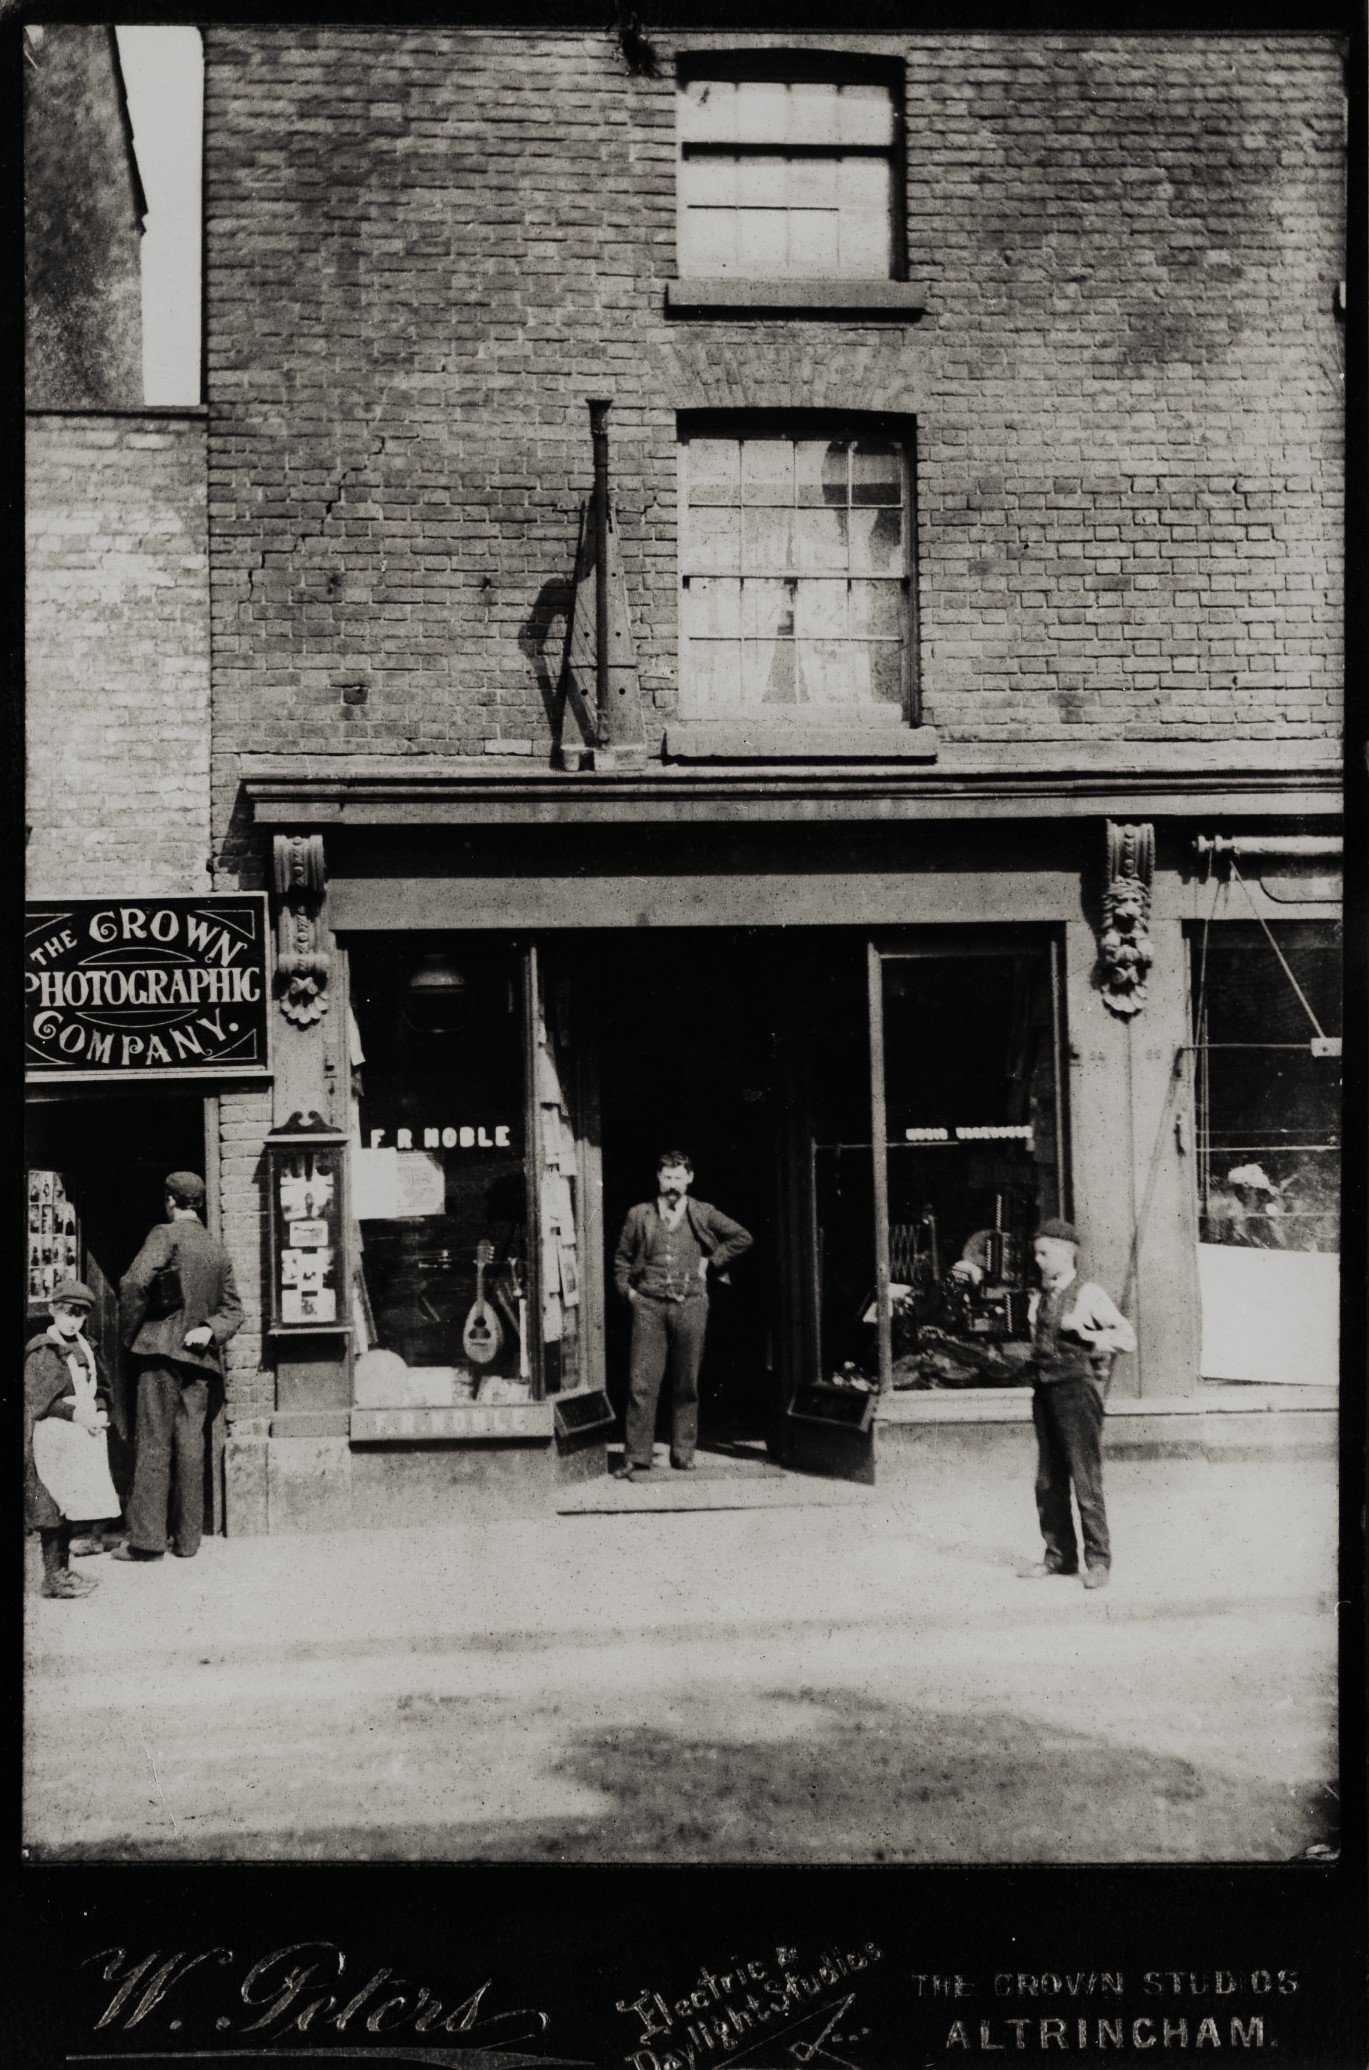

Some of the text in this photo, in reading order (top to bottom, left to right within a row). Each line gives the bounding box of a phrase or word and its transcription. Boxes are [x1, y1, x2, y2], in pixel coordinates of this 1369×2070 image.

[30, 907, 248, 967] THE CROWN
[33, 1007, 239, 1065] COMPANY.
[424, 1126, 510, 1148] NOBLE
[911, 1974, 973, 1998] THE
[994, 1971, 1124, 1998] CROWN
